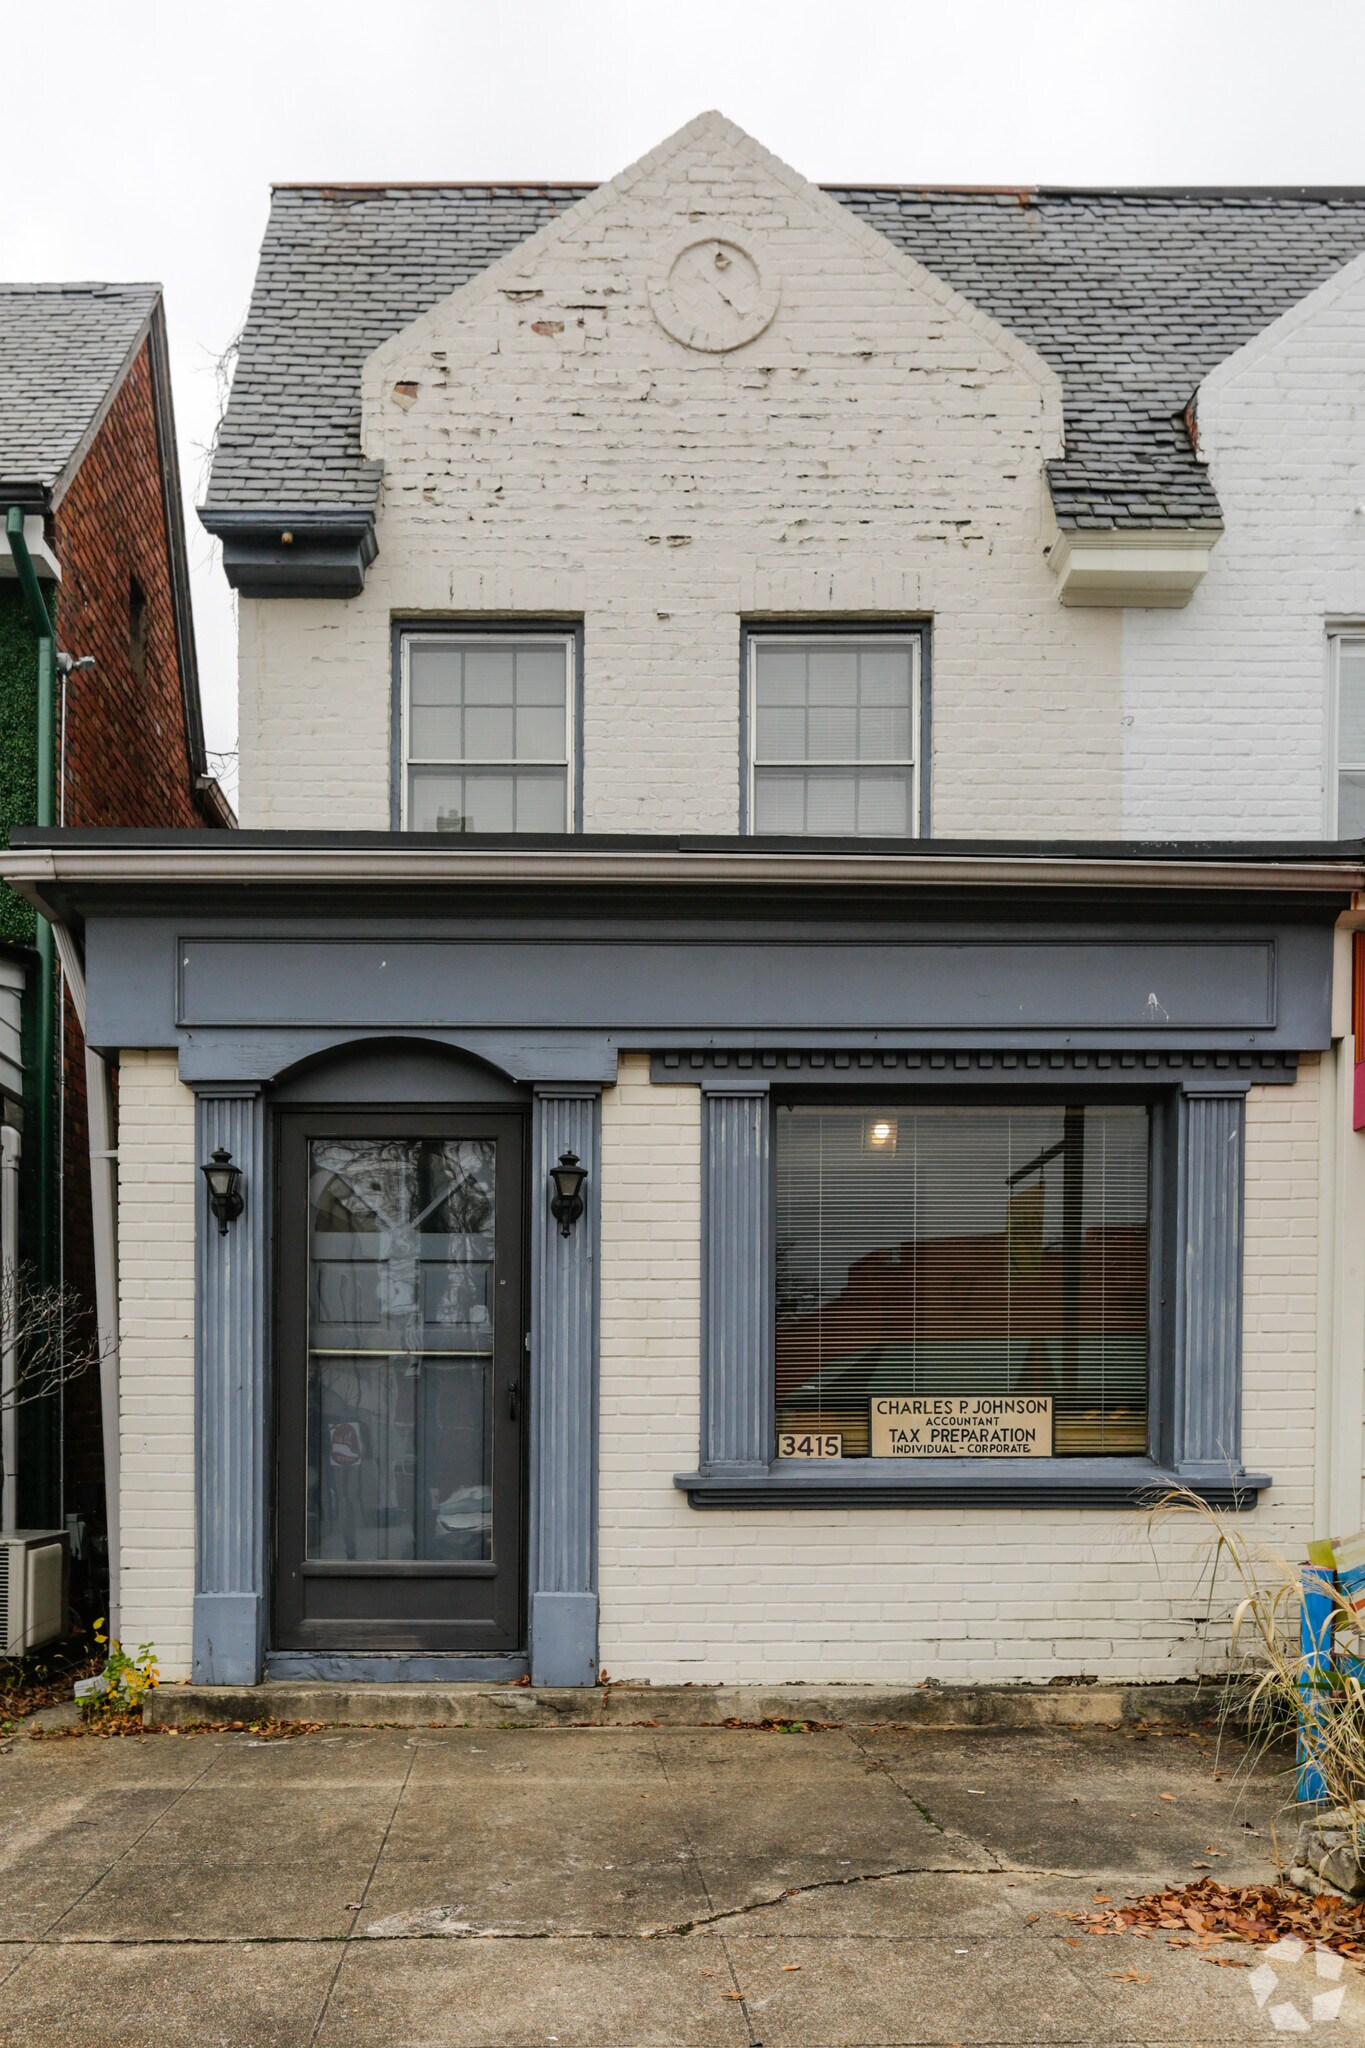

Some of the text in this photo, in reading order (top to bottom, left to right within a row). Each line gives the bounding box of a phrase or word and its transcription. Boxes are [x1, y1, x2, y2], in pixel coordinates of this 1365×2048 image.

[877, 1400, 1048, 1415] CHARLES P. JOHNSON
[925, 1416, 1000, 1426] ACCOUNTANT
[889, 1428, 1036, 1443] TAX PREPARATION
[782, 1435, 839, 1457] 3415
[892, 1444, 956, 1454] INDIVIDUAL
[967, 1443, 1031, 1453] CORPORATE
